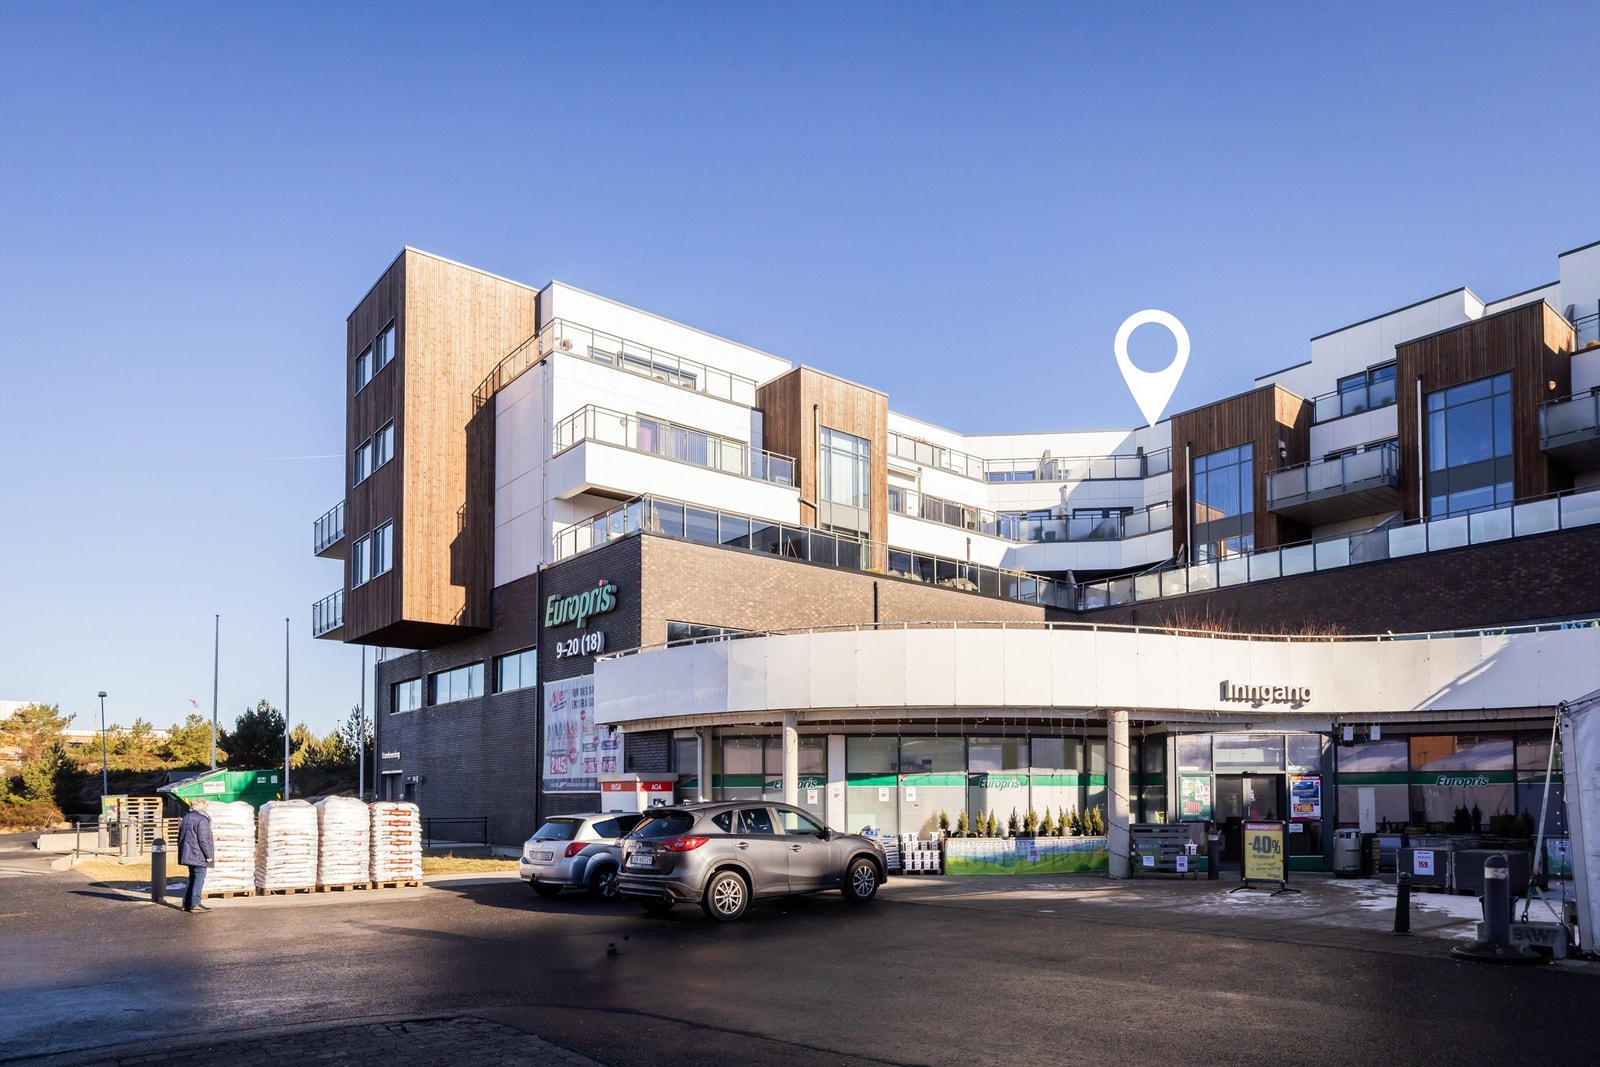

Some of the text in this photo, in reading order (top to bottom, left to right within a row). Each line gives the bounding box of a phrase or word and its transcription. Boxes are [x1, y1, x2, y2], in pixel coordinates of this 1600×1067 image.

[545, 579, 615, 628] Europris
[581, 631, 602, 655] (18)
[1222, 679, 1312, 708] Inngang
[978, 777, 1021, 791] Europris
[1436, 775, 1489, 788] Europris
[1248, 836, 1281, 854] -40%
